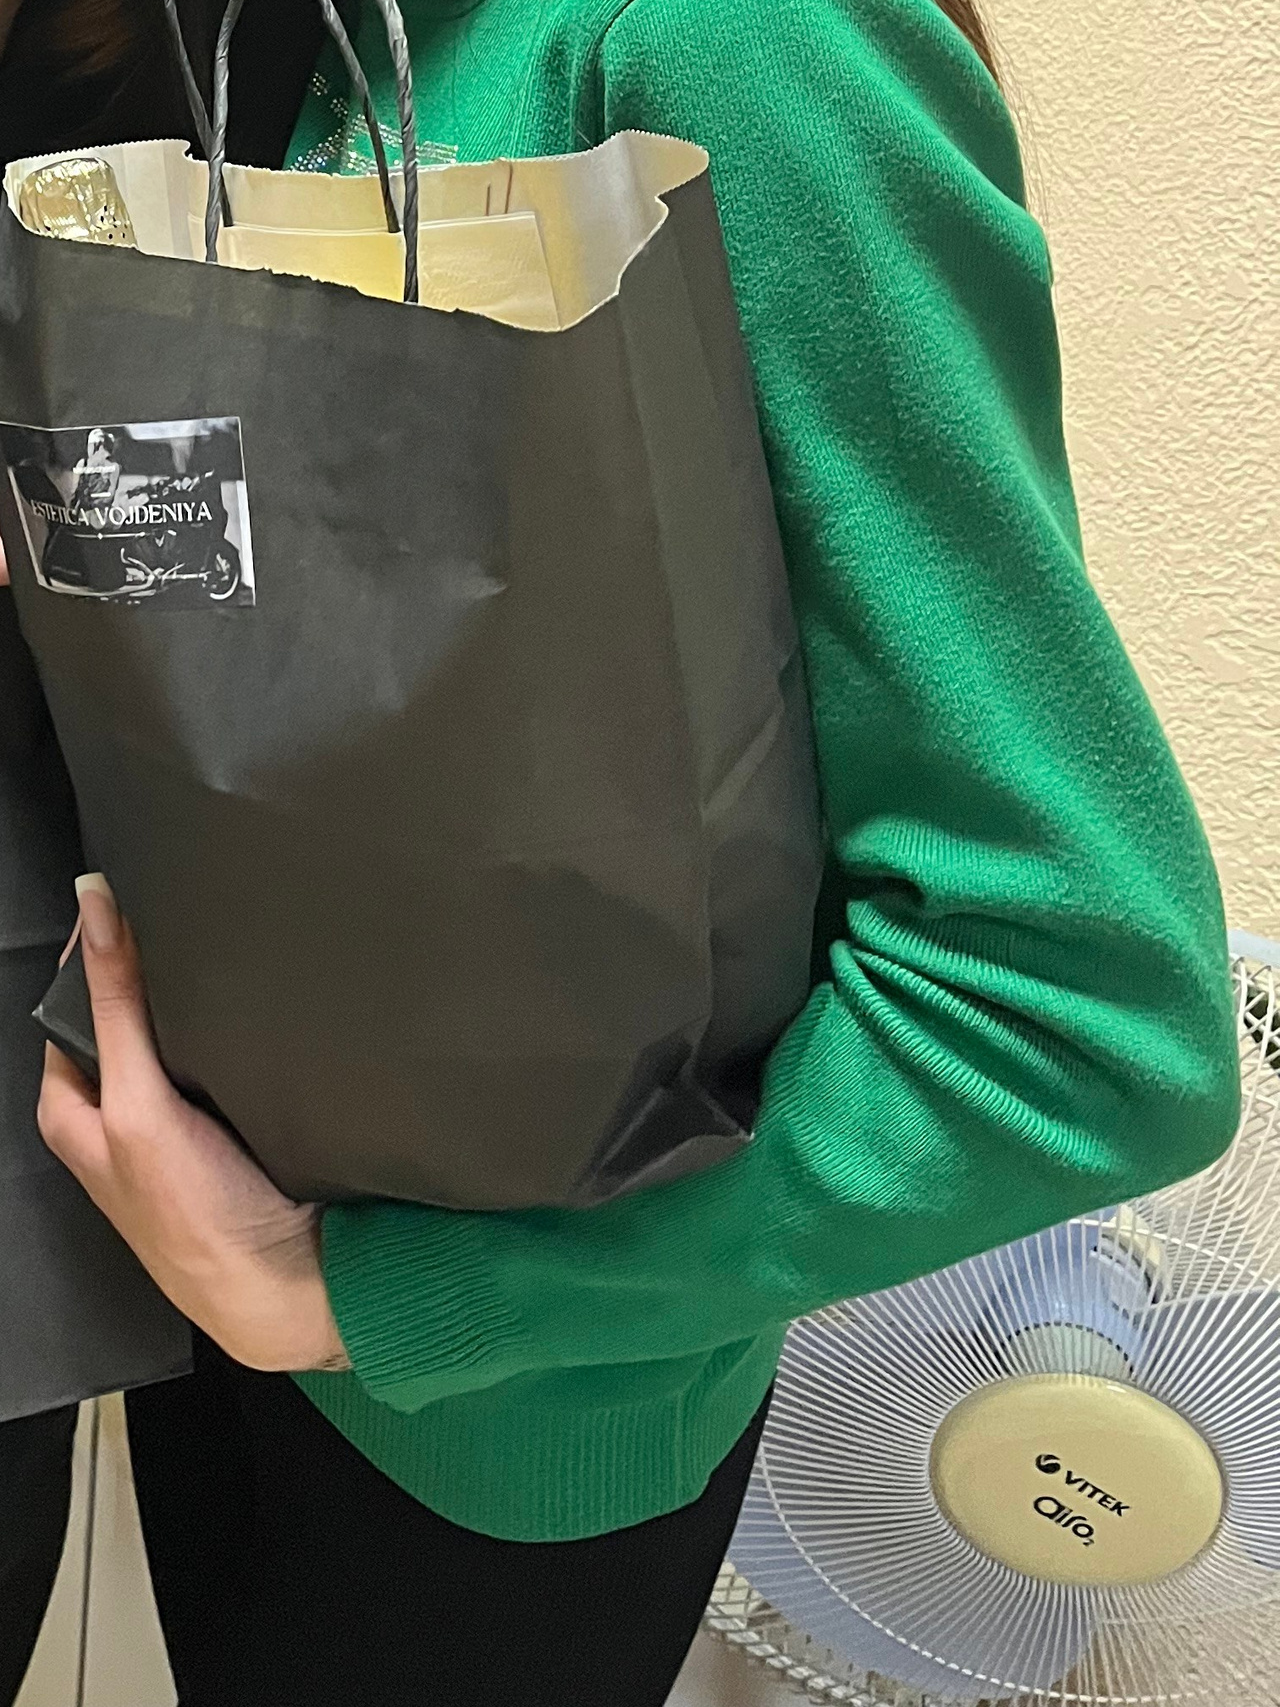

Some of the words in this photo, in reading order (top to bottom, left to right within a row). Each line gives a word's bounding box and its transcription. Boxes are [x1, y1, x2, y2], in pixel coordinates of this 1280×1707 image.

[30, 499, 89, 526] ESTETICA
[94, 501, 213, 526] VOJDENIYA
[1065, 1470, 1131, 1517] VITEK
